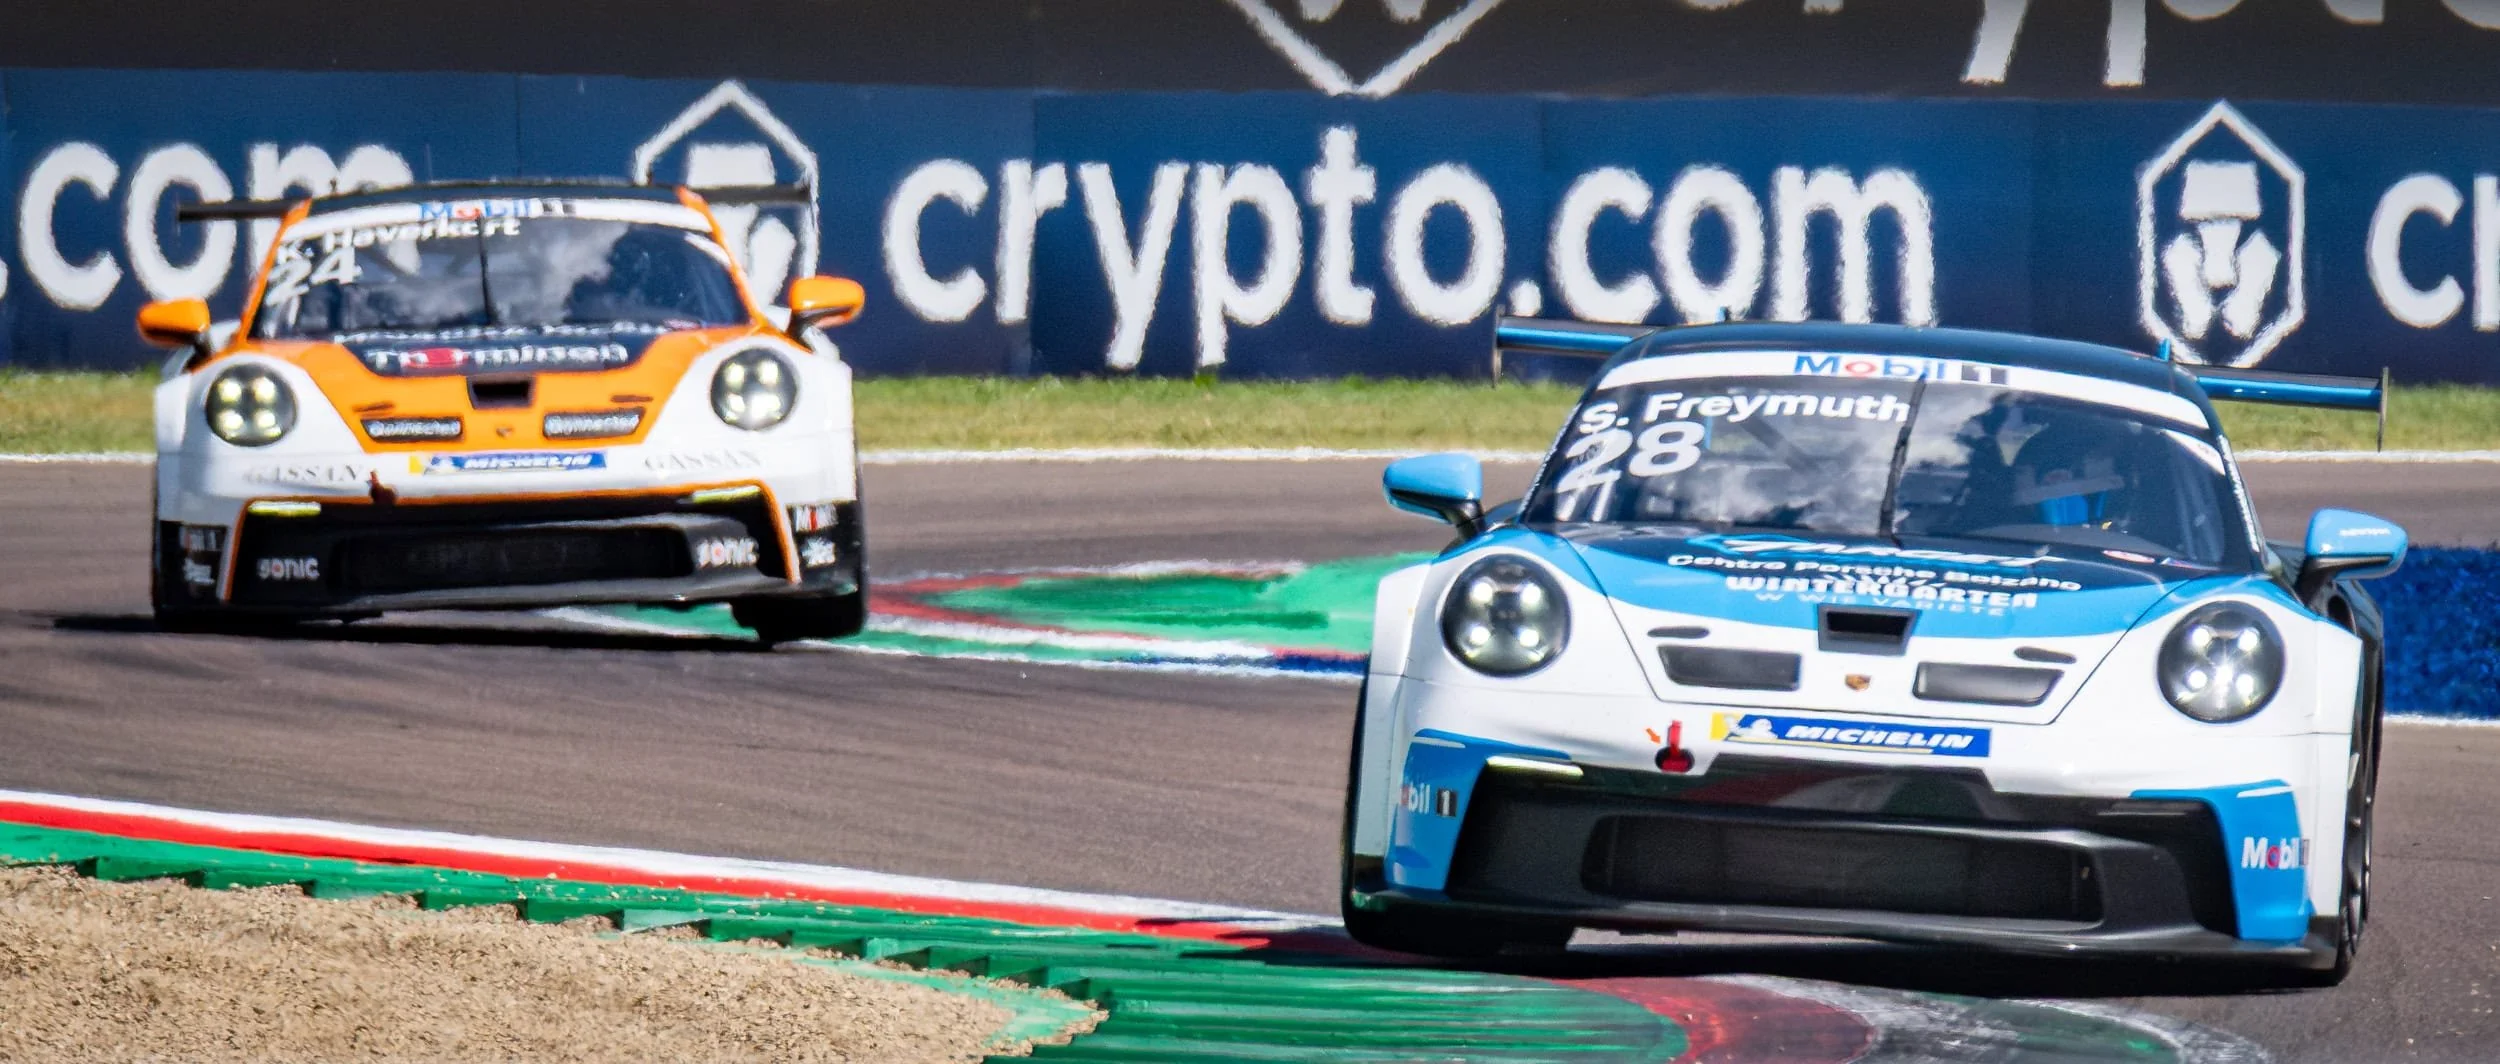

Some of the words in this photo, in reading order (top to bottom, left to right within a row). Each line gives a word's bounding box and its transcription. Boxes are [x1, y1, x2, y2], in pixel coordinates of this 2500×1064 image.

[882, 125, 1937, 369] crypto.com
[265, 247, 362, 306] 24
[1794, 353, 1945, 380] Mobil
[1578, 401, 1629, 434] S.
[1643, 392, 1910, 423] Freymuth
[1556, 420, 1706, 495] 28
[1668, 555, 1786, 570] Centro
[1794, 561, 1936, 578] Porsche
[1944, 571, 2082, 591] Bolzano
[1726, 576, 2038, 608] WINTERGARTEN
[1785, 725, 1974, 750] MICHELIN
